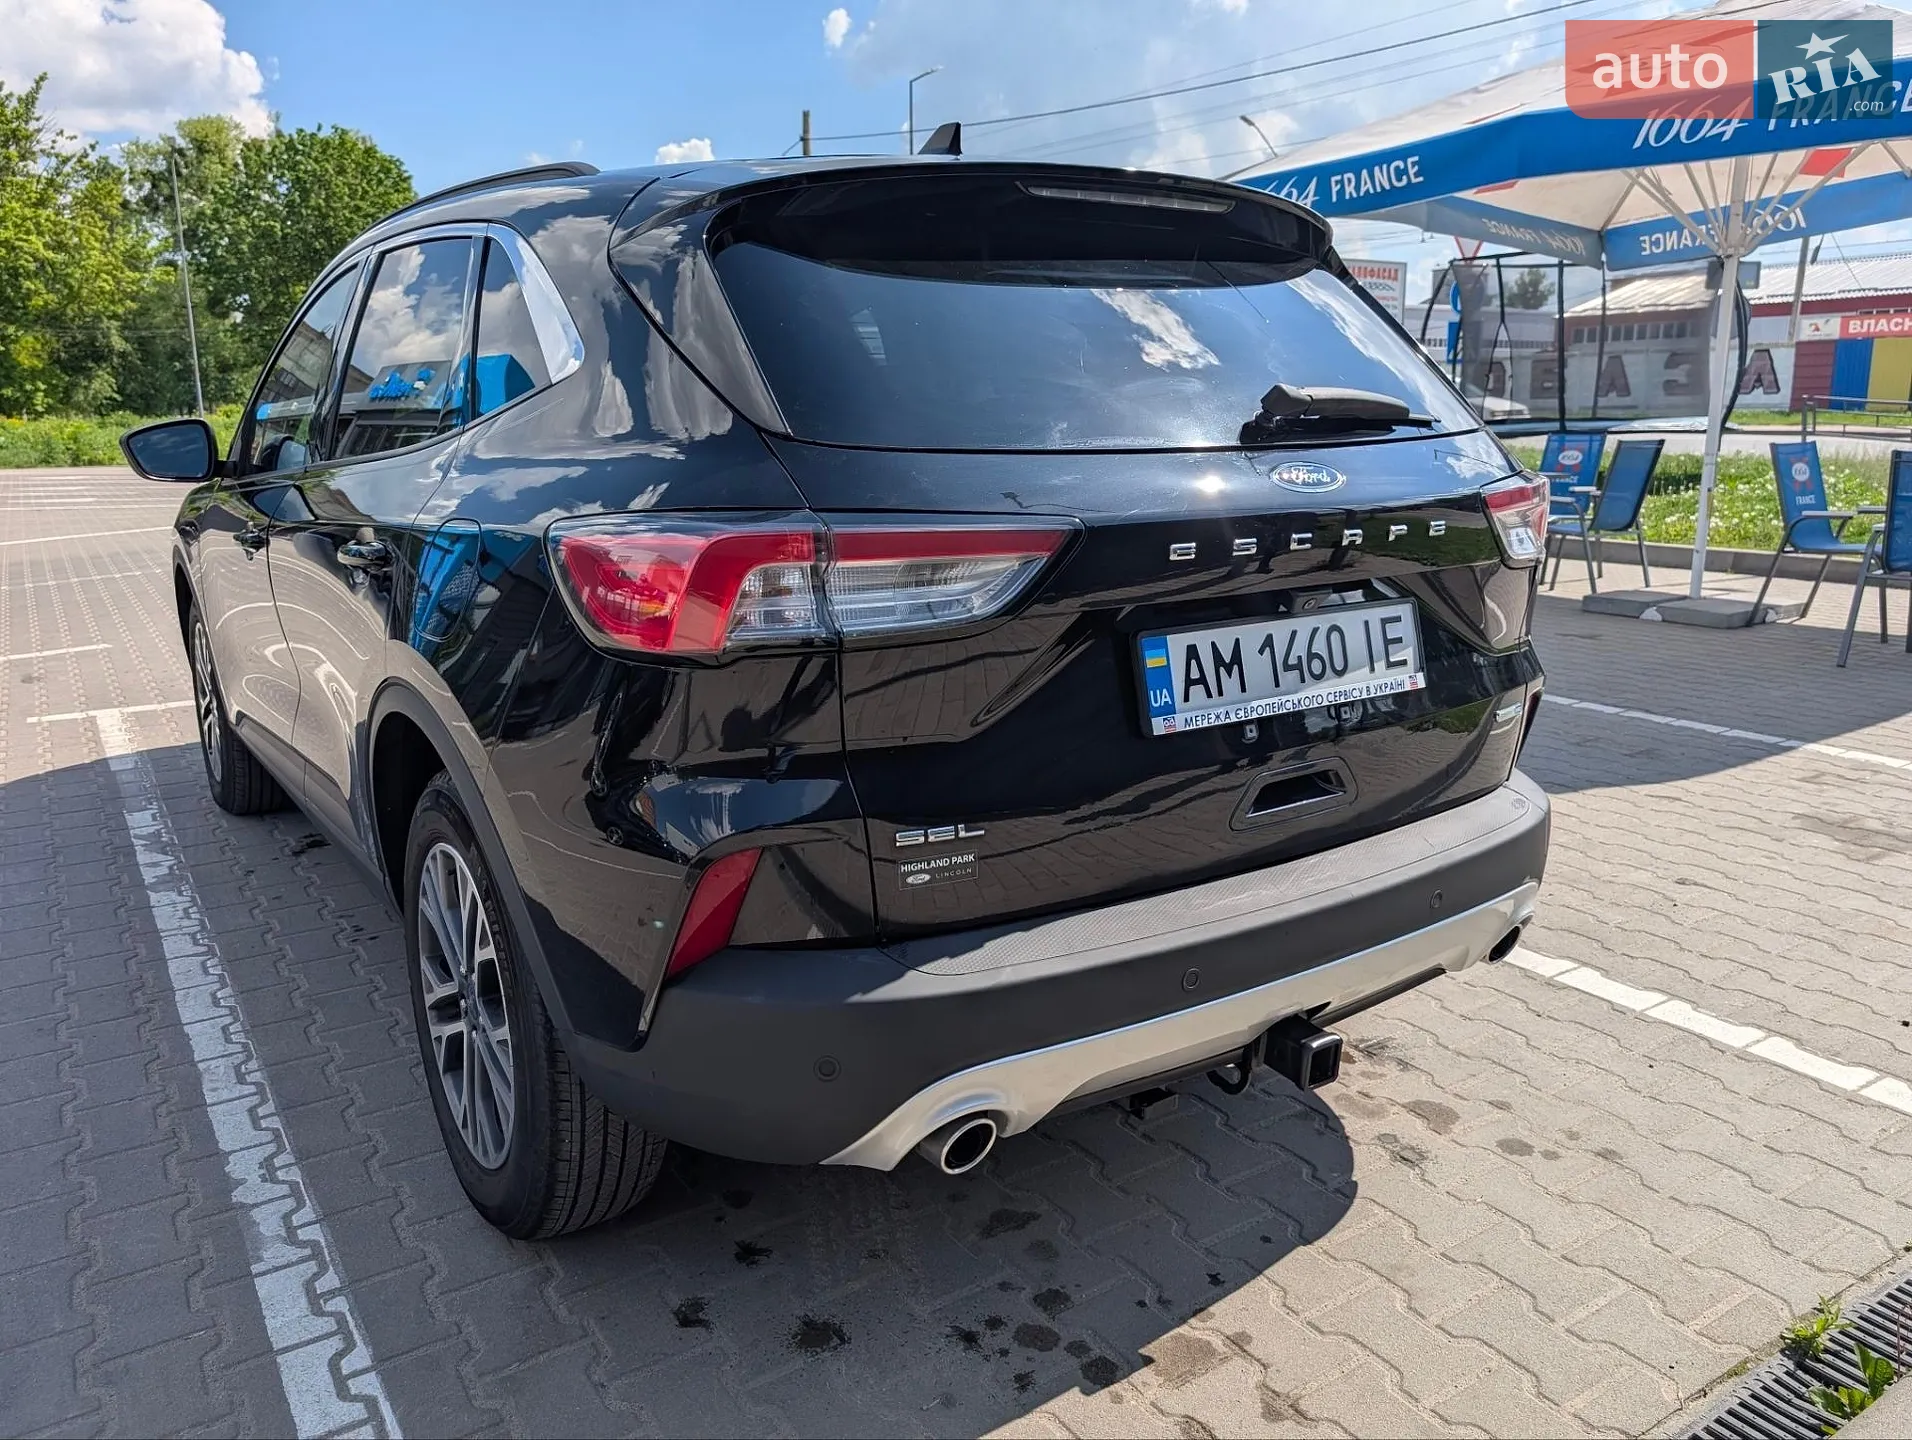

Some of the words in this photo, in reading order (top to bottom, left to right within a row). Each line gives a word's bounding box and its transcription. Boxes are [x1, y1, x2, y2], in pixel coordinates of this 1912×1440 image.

[1632, 95, 1752, 149] 1664
[1330, 156, 1424, 203] FRANCE
[1290, 465, 1331, 484] Ford
[1169, 520, 1447, 561] ESCAPE
[1183, 636, 1247, 703] AM
[1257, 623, 1349, 689] 1460
[1363, 614, 1408, 675] IE
[1150, 688, 1172, 707] UA
[1184, 710, 1232, 728] МЕРЕЖА
[1235, 693, 1324, 720] ЄВРОПЕЙСЬКОГО
[1326, 685, 1363, 704] СЕРВІСУ
[1365, 686, 1372, 697] В
[1373, 677, 1405, 696] УКРАЇНІ
[895, 824, 985, 847] SEL
[900, 858, 950, 873] HIGHLAND
[951, 853, 975, 865] PARK
[935, 868, 972, 878] LINCOLN
